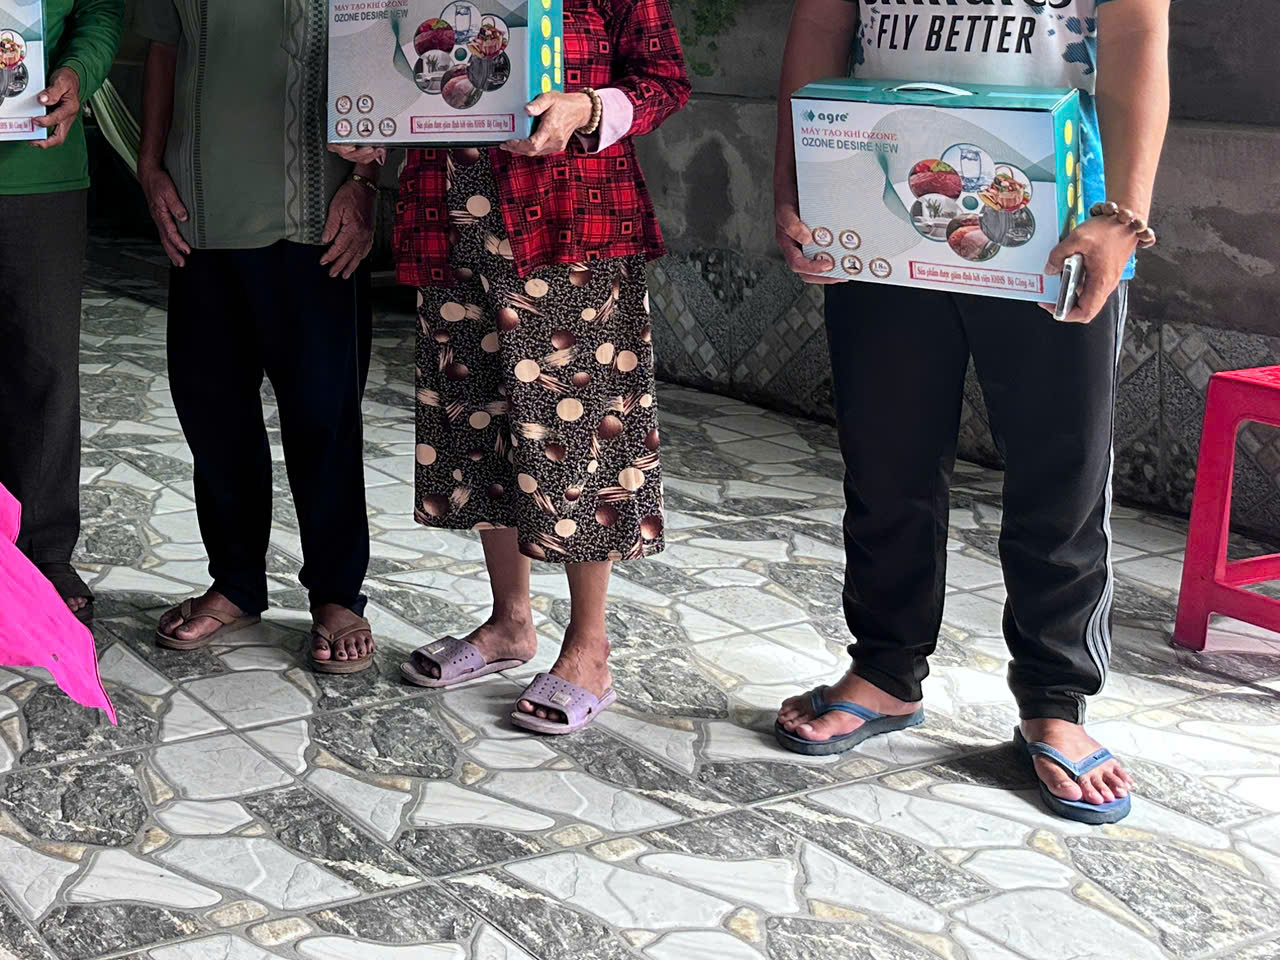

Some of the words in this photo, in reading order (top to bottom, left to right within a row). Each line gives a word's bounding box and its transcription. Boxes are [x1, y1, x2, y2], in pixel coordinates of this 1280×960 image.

[334, 12, 360, 23] OZONE
[360, 10, 389, 20] DESIRE
[390, 8, 408, 19] NEW
[876, 14, 918, 51] FLY
[924, 14, 1036, 54] BETTER
[862, 131, 897, 141] OZONE
[801, 137, 835, 149] OZONE
[836, 140, 874, 152] DESIRE
[875, 143, 899, 154] NEW
